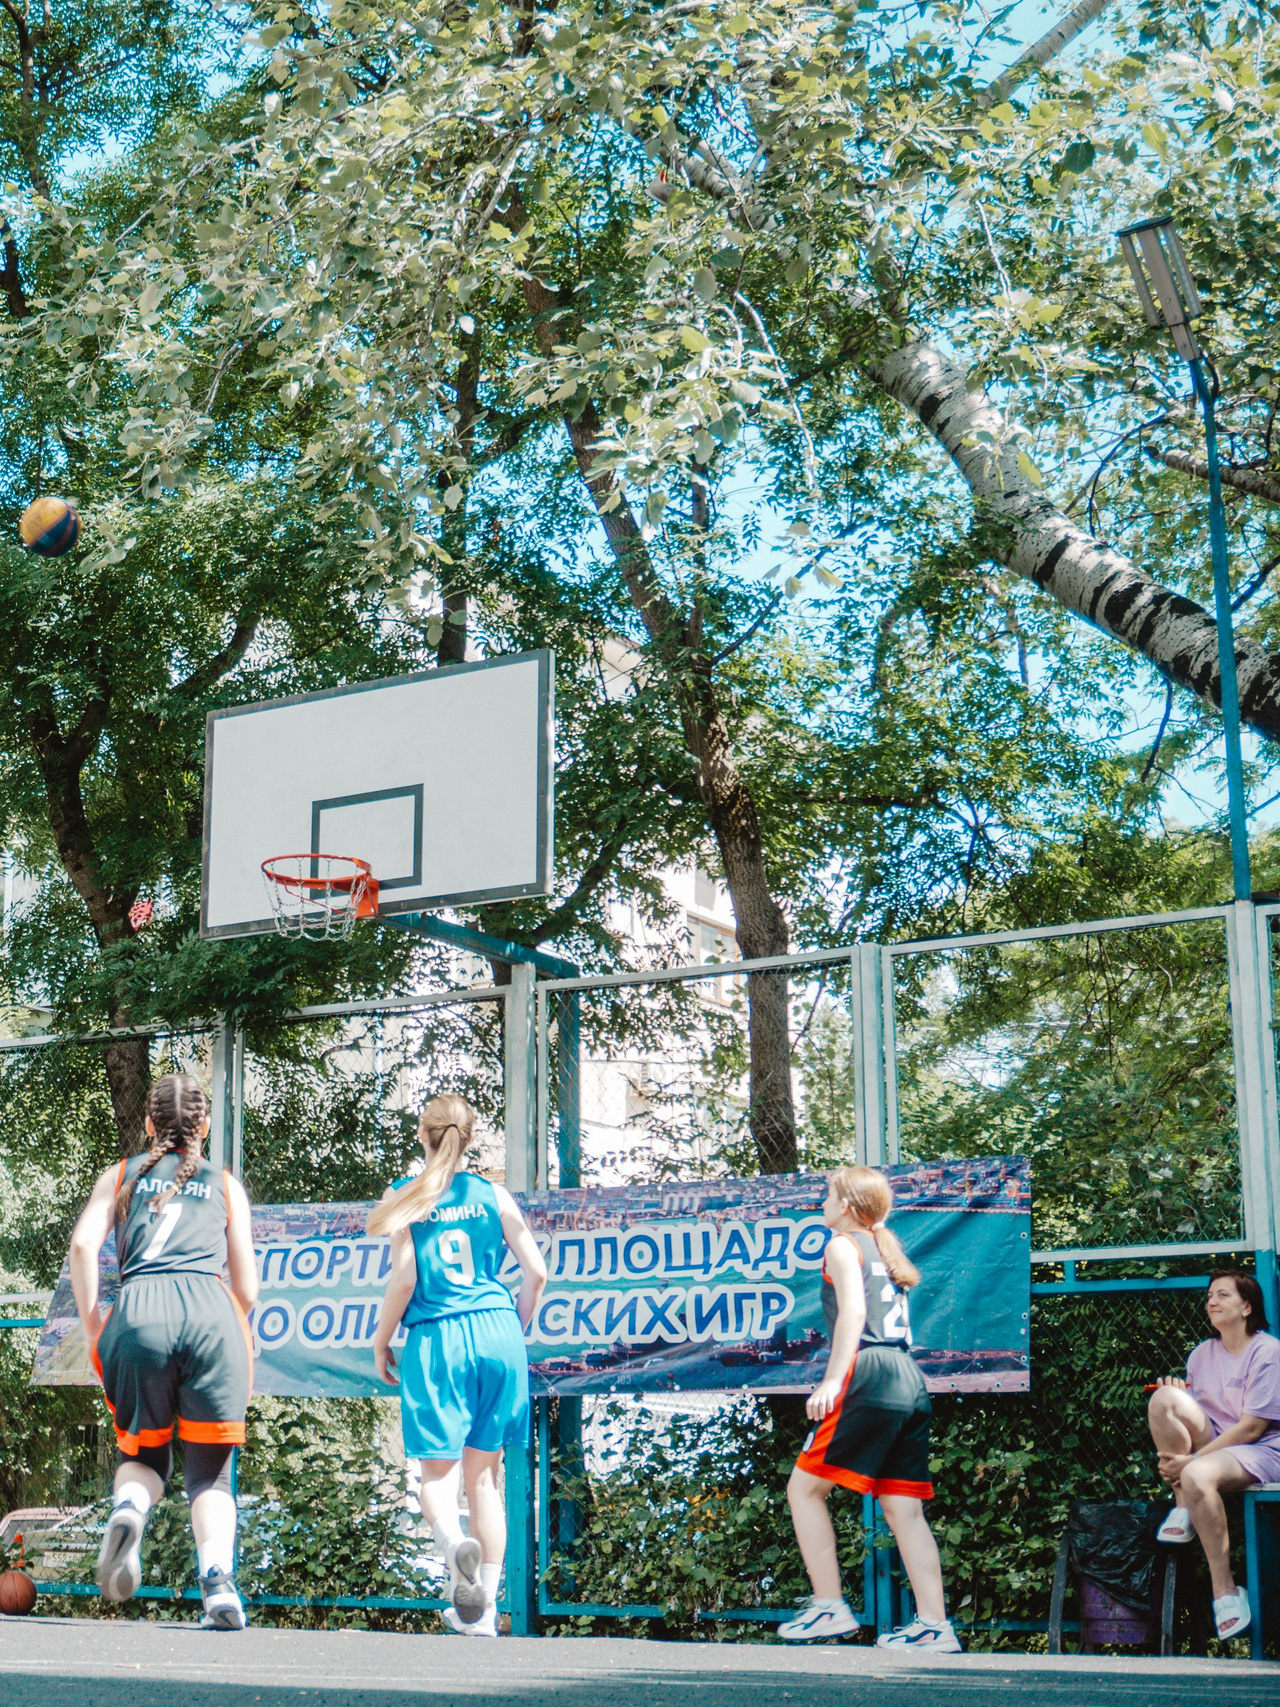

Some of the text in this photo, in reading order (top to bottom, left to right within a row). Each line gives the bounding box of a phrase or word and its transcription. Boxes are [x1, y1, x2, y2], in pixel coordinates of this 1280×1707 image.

[141, 1202, 183, 1260] 7
[421, 1203, 489, 1223] ОМИНА
[438, 1228, 476, 1286] 9
[555, 1223, 833, 1276] ПЛОЩАДО
[247, 1304, 290, 1350] О
[694, 1291, 788, 1336] ИГР
